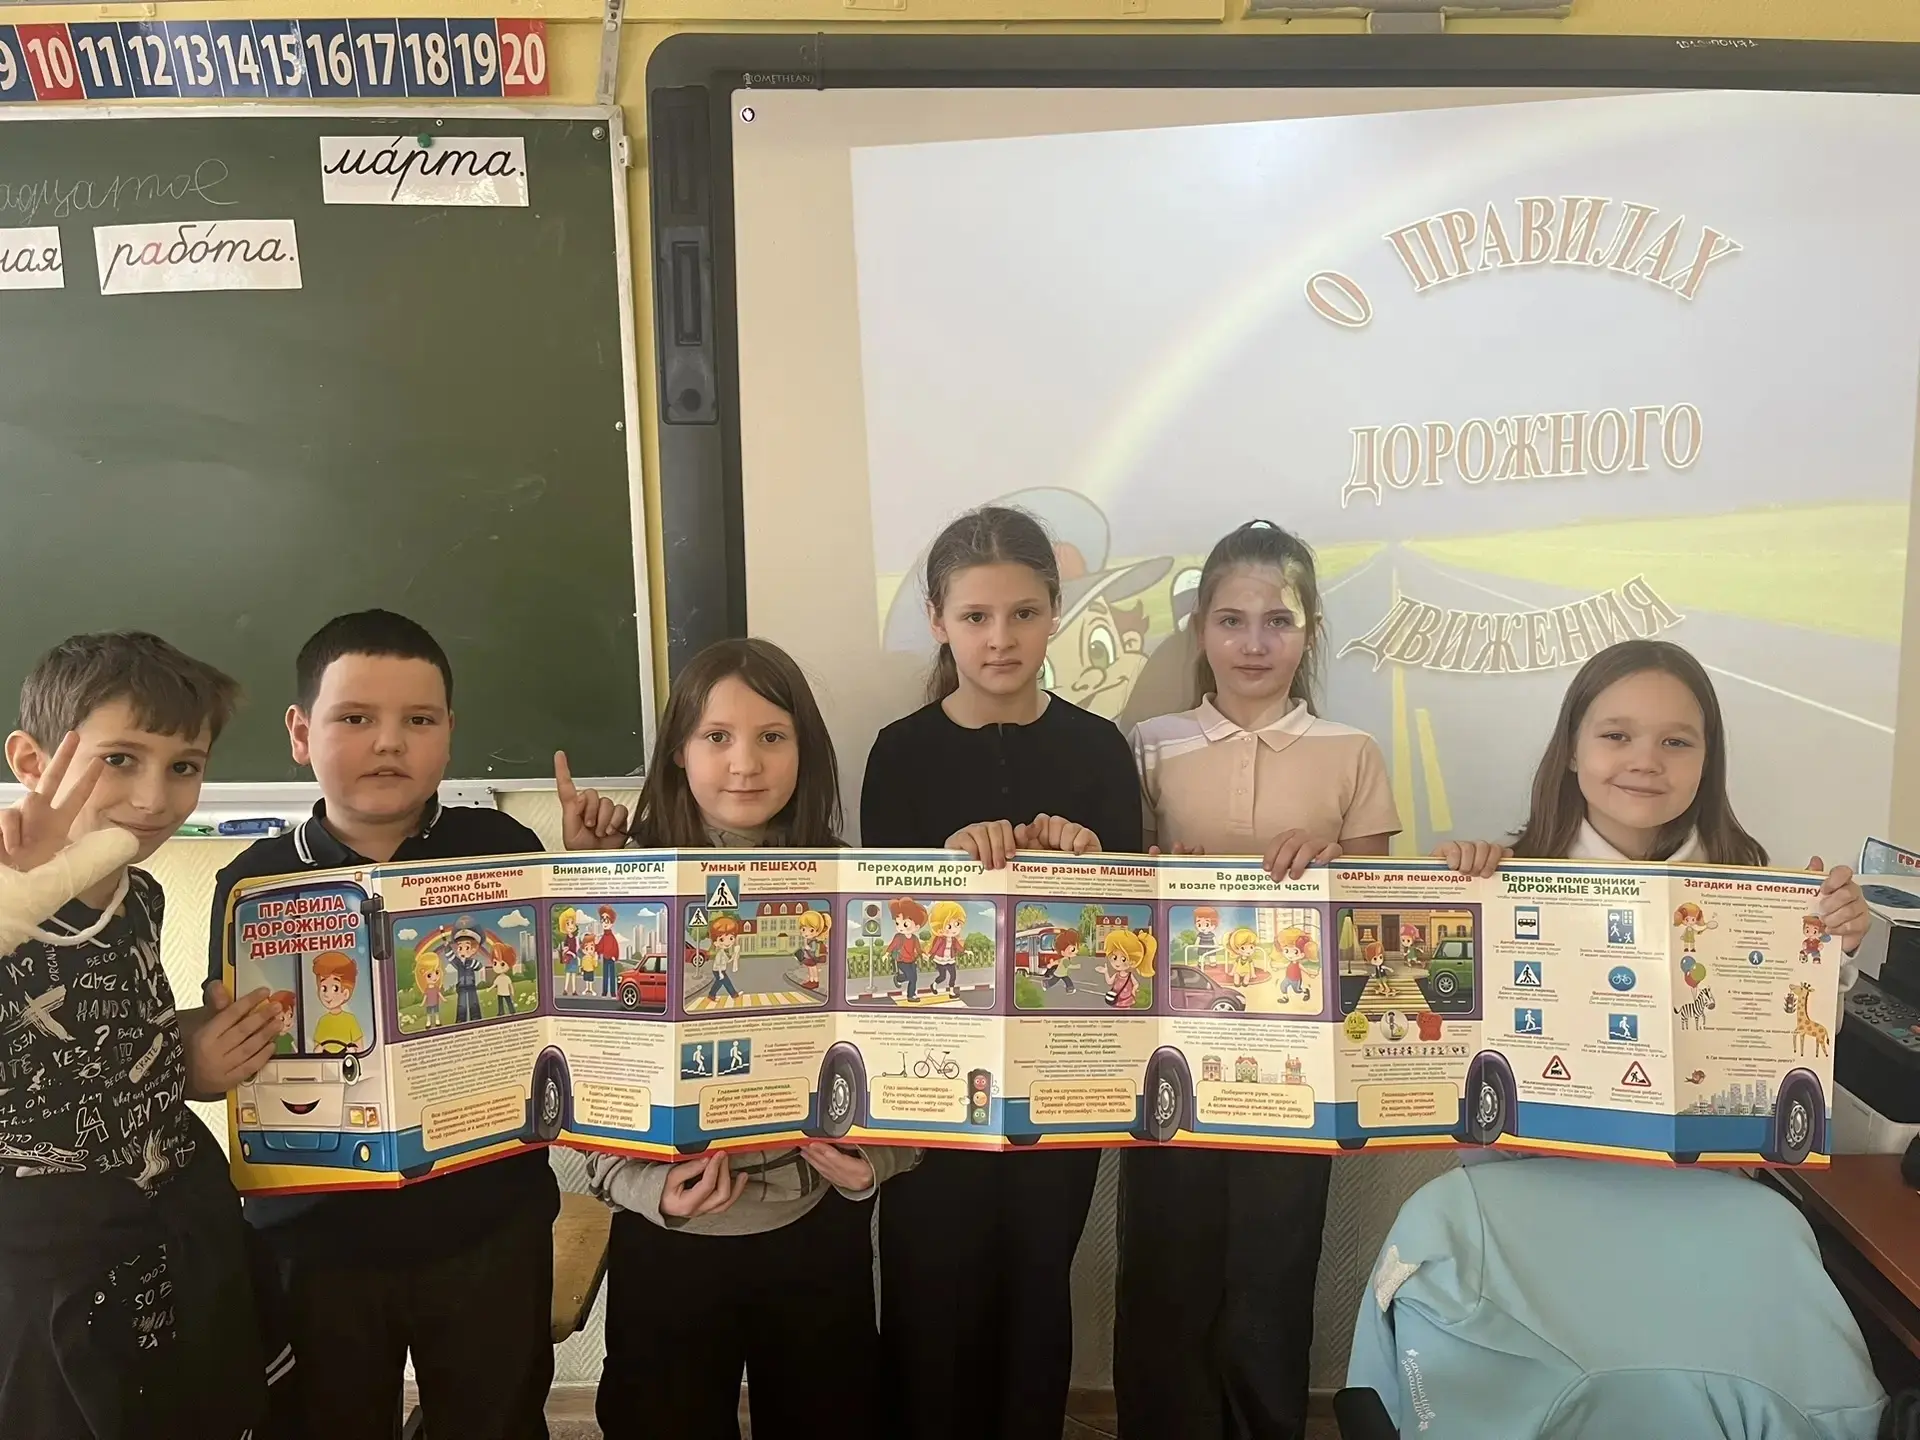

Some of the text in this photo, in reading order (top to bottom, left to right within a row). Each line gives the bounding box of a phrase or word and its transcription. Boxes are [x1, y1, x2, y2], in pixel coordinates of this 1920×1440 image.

[29, 39, 73, 88] 10
[79, 37, 123, 86] 11
[129, 39, 173, 86] 12
[175, 38, 214, 86] 13
[218, 38, 260, 86] 14
[261, 36, 301, 84] 15
[306, 37, 352, 86] 16
[356, 36, 397, 85] 17
[405, 34, 449, 85] 18
[454, 34, 497, 84] 19
[501, 33, 545, 85] 20
[1305, 196, 1743, 327] О ПРАВИЛАХ
[1341, 403, 1702, 508] ДОРОЖНОГО
[1337, 574, 1686, 673] ДВИЖЕНИЯ
[553, 862, 665, 875] Внимание, ДОРОГА!
[700, 861, 817, 873] Умный ПЕШЕХОД
[858, 862, 985, 876] Переходим дорогу
[1012, 863, 1155, 877] Какие разные МАШИНЫ!
[401, 868, 523, 888] Дорожное движение
[876, 876, 967, 887] ПРАВИЛЬНО!
[1216, 872, 1232, 881] Во
[1336, 872, 1472, 883] «ФАРЫ» для пешеходов
[1502, 874, 1632, 886] Верные помощники
[426, 879, 502, 895] должно быть
[1180, 882, 1215, 890] возле
[1285, 883, 1319, 891] части
[1507, 884, 1640, 896] ДОРОЖНЫЕ ЗНАКИ
[1684, 879, 1821, 897] Загадки на смекалку
[420, 890, 508, 906] БЕЗОПАСНЫМ!
[258, 896, 345, 918] ПРАВИЛА
[242, 913, 360, 941] ДОРОЖНОГО
[250, 933, 356, 959] ДВИЖЕНИЯ
[120, 1097, 152, 1138] LAZY
[154, 1076, 186, 1112] DAY
